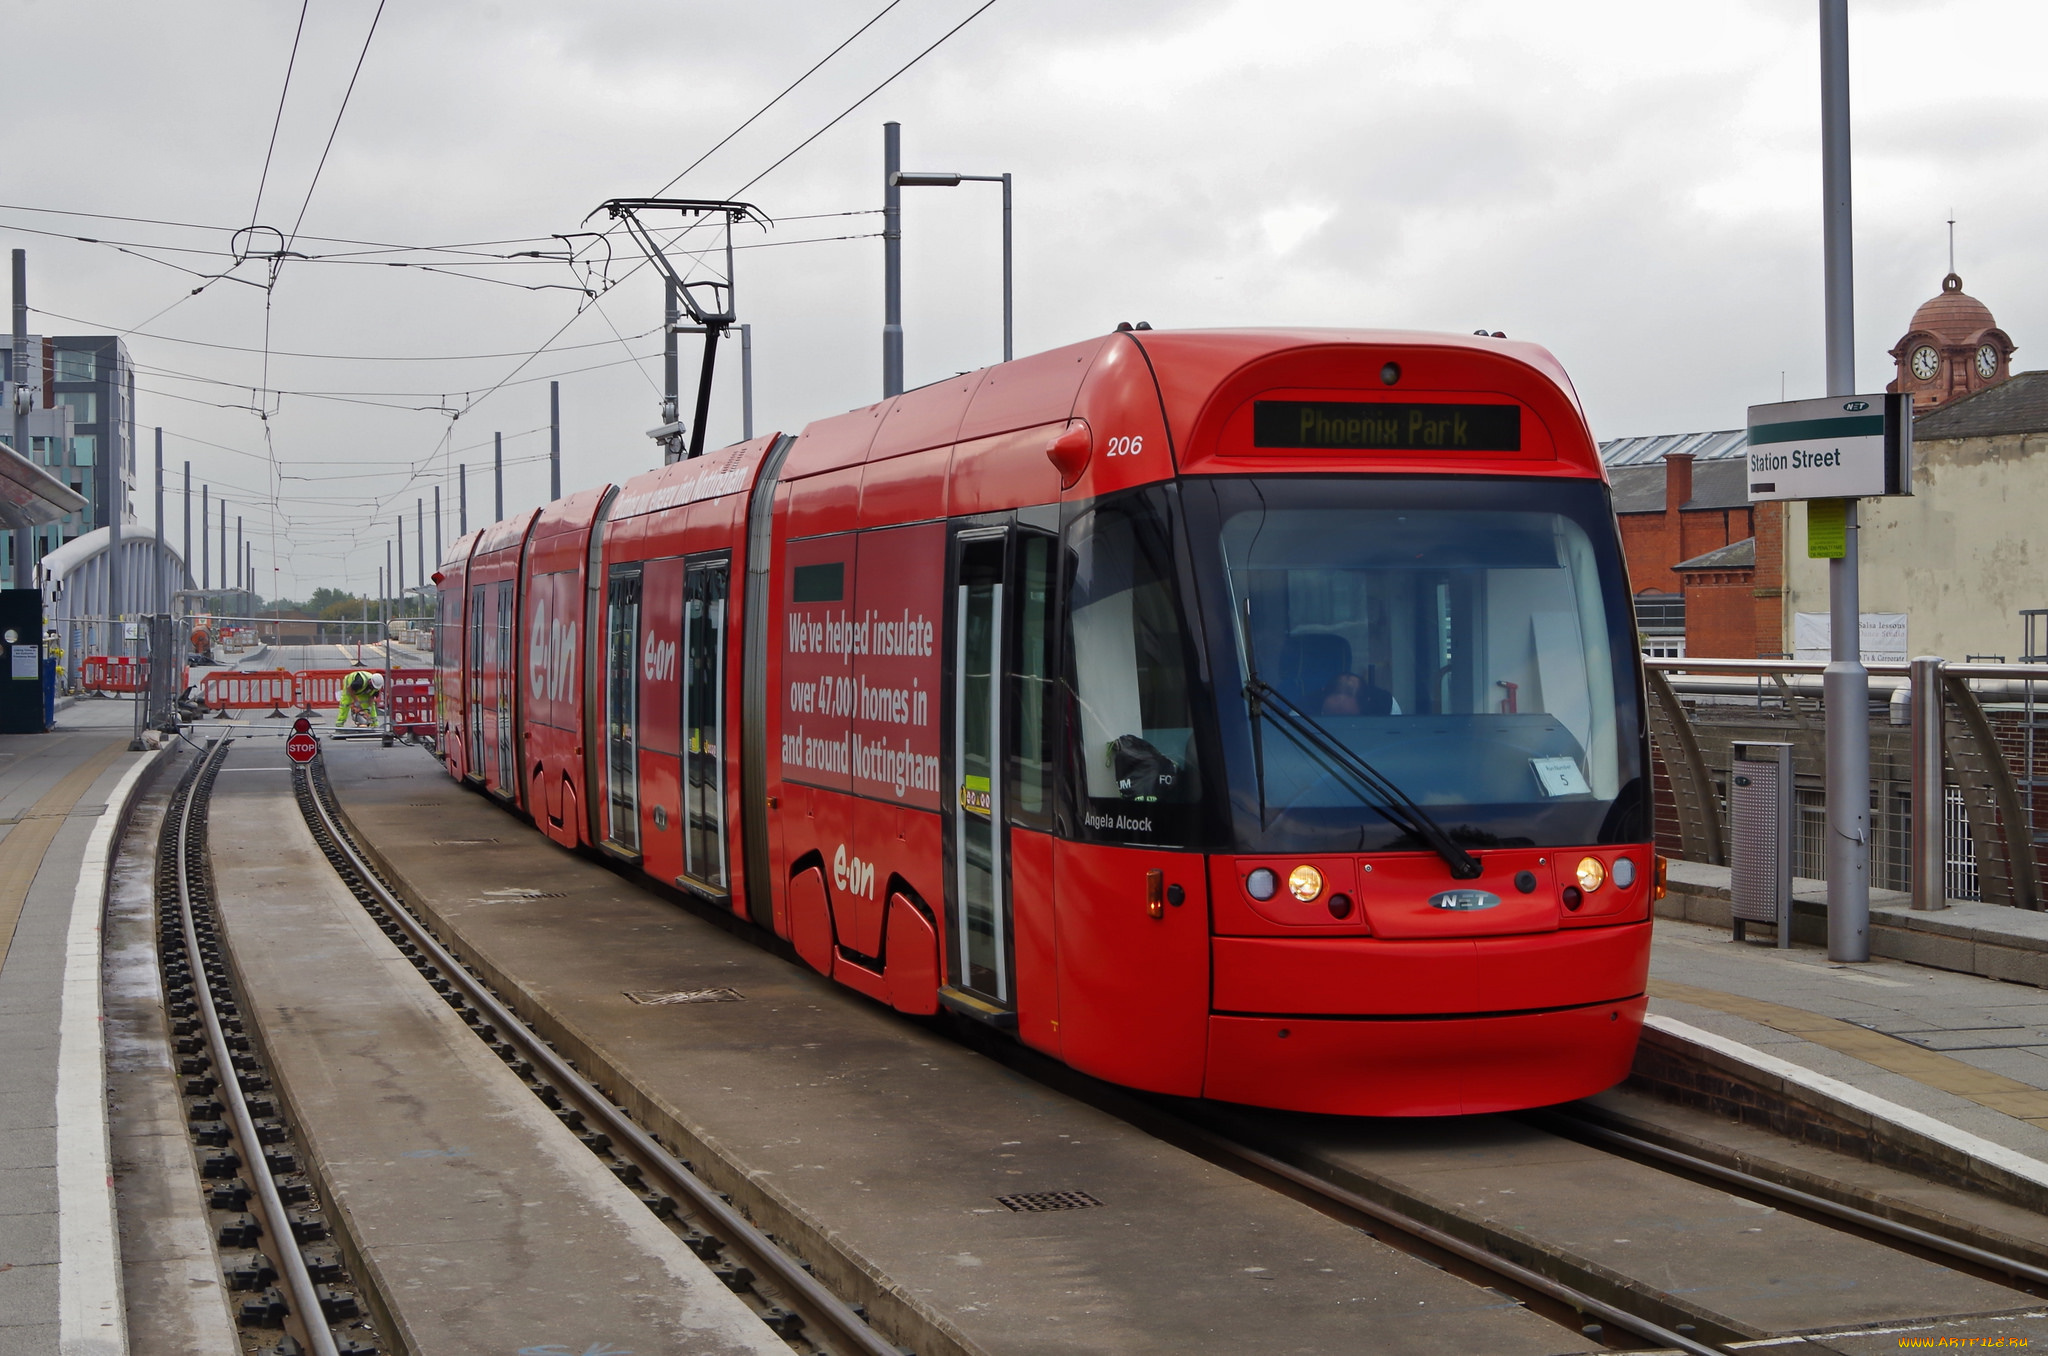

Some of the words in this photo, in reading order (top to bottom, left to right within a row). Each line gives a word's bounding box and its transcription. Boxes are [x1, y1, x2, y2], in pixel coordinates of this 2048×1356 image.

[1846, 402, 1866, 411] NET
[1301, 407, 1398, 444] Phoenix
[1408, 409, 1468, 446] Park
[1106, 435, 1143, 457] 206
[1751, 452, 1788, 472] Station
[1792, 448, 1841, 469] Street
[692, 465, 749, 507] Nottingham
[1858, 621, 1876, 629] Salsa
[1878, 621, 1905, 629] lessons
[789, 612, 823, 653] We've
[825, 609, 870, 665] helped
[872, 608, 933, 657] insulate
[1877, 653, 1905, 662] Corporate
[790, 680, 816, 713] over
[818, 675, 858, 718] 47,000
[861, 674, 909, 725] homes
[913, 677, 927, 726] in
[289, 744, 315, 752] STOP
[782, 725, 802, 766] and
[805, 730, 849, 775] around
[852, 733, 940, 797] Nottingham
[1559, 774, 1569, 786] 5
[1084, 811, 1114, 830] Angela
[1116, 815, 1152, 832] Alcock
[1441, 893, 1489, 908] NET
